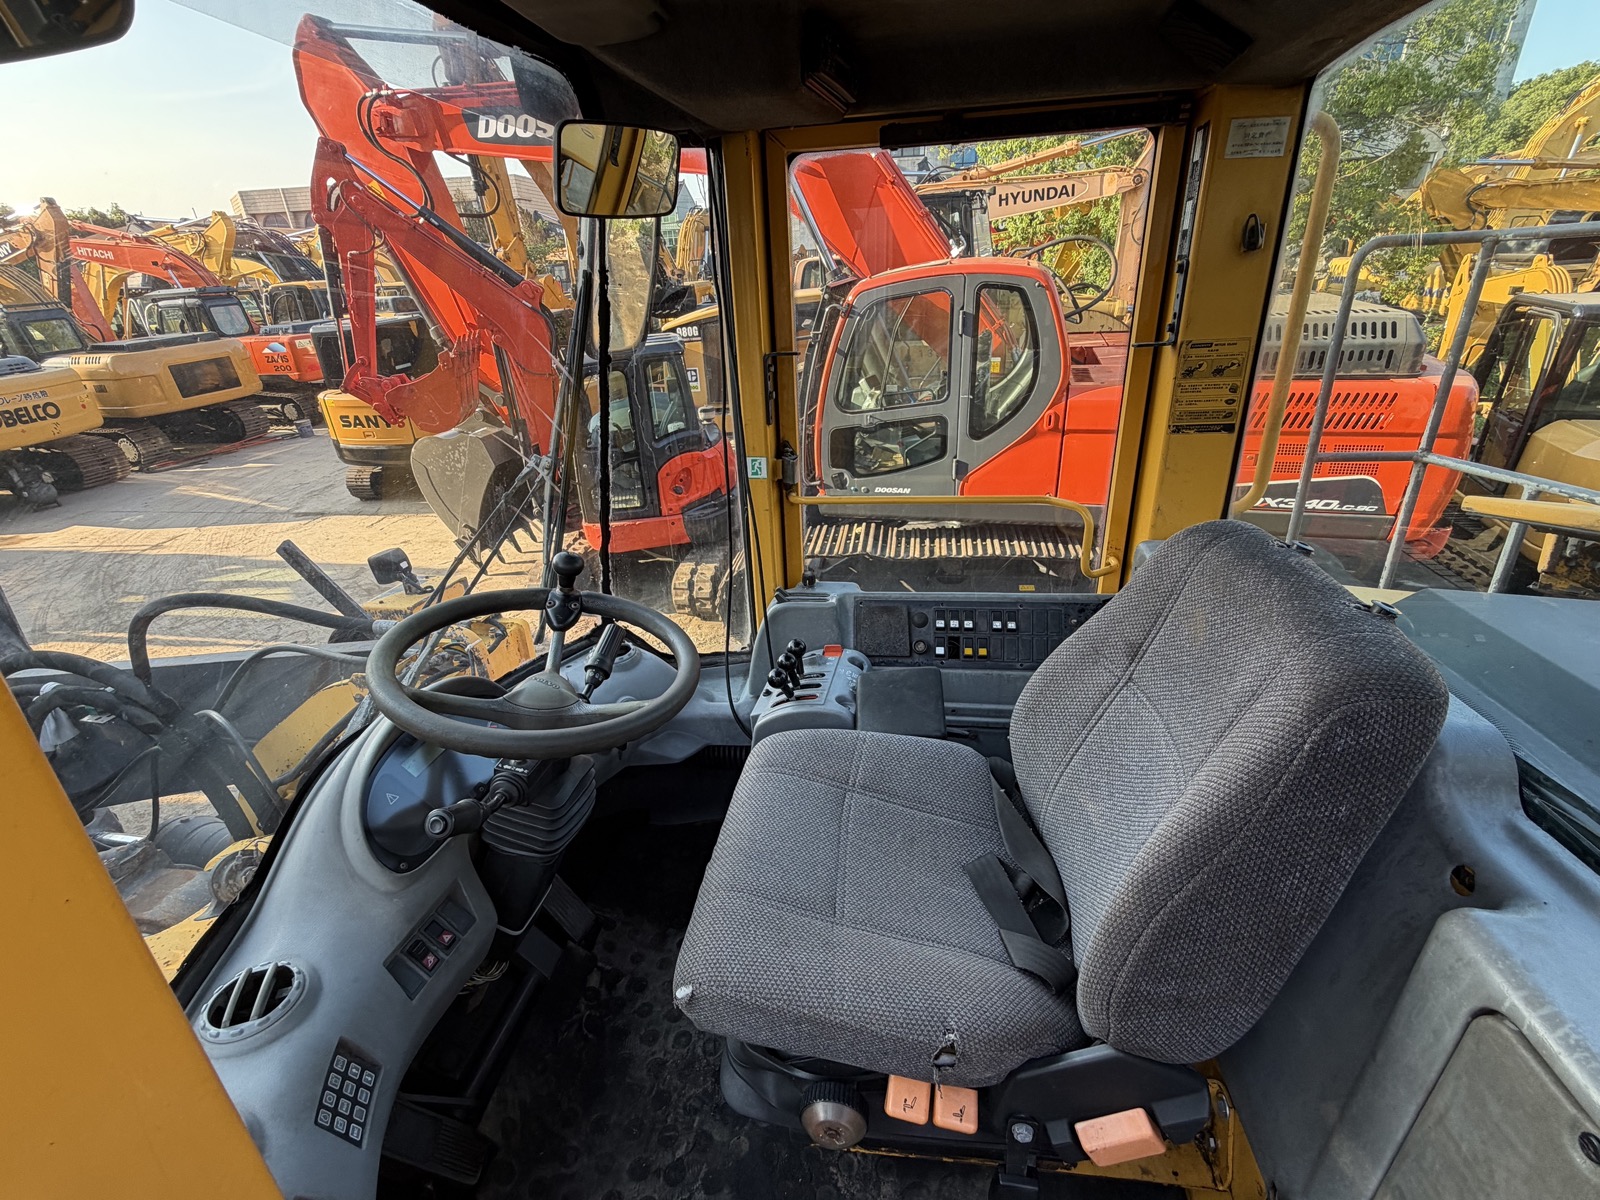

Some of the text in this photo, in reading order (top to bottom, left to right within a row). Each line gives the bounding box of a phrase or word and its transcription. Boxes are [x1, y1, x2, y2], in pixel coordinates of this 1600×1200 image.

[477, 114, 555, 138] DOOS
[998, 184, 1076, 207] HYUNDAI
[76, 246, 115, 261] HITACHI
[0, 401, 61, 428] BELCO
[339, 415, 392, 429] SANY
[874, 486, 911, 494] DOOSAN
